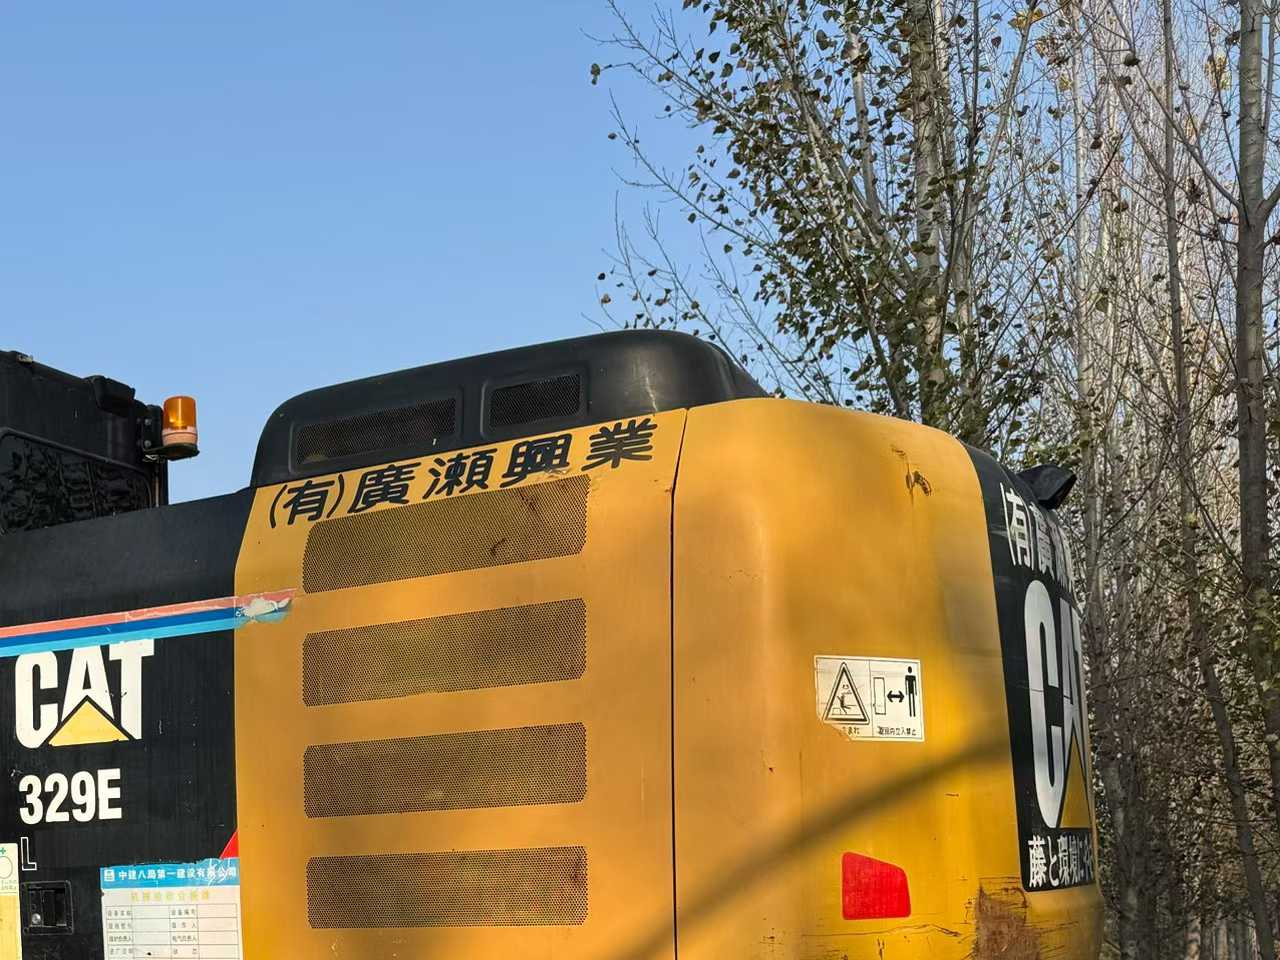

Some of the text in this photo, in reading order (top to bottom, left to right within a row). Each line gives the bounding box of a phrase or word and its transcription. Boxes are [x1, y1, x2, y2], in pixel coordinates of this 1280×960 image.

[15, 639, 154, 748] CAT
[19, 767, 123, 826] 329E
[20, 837, 38, 871] L
